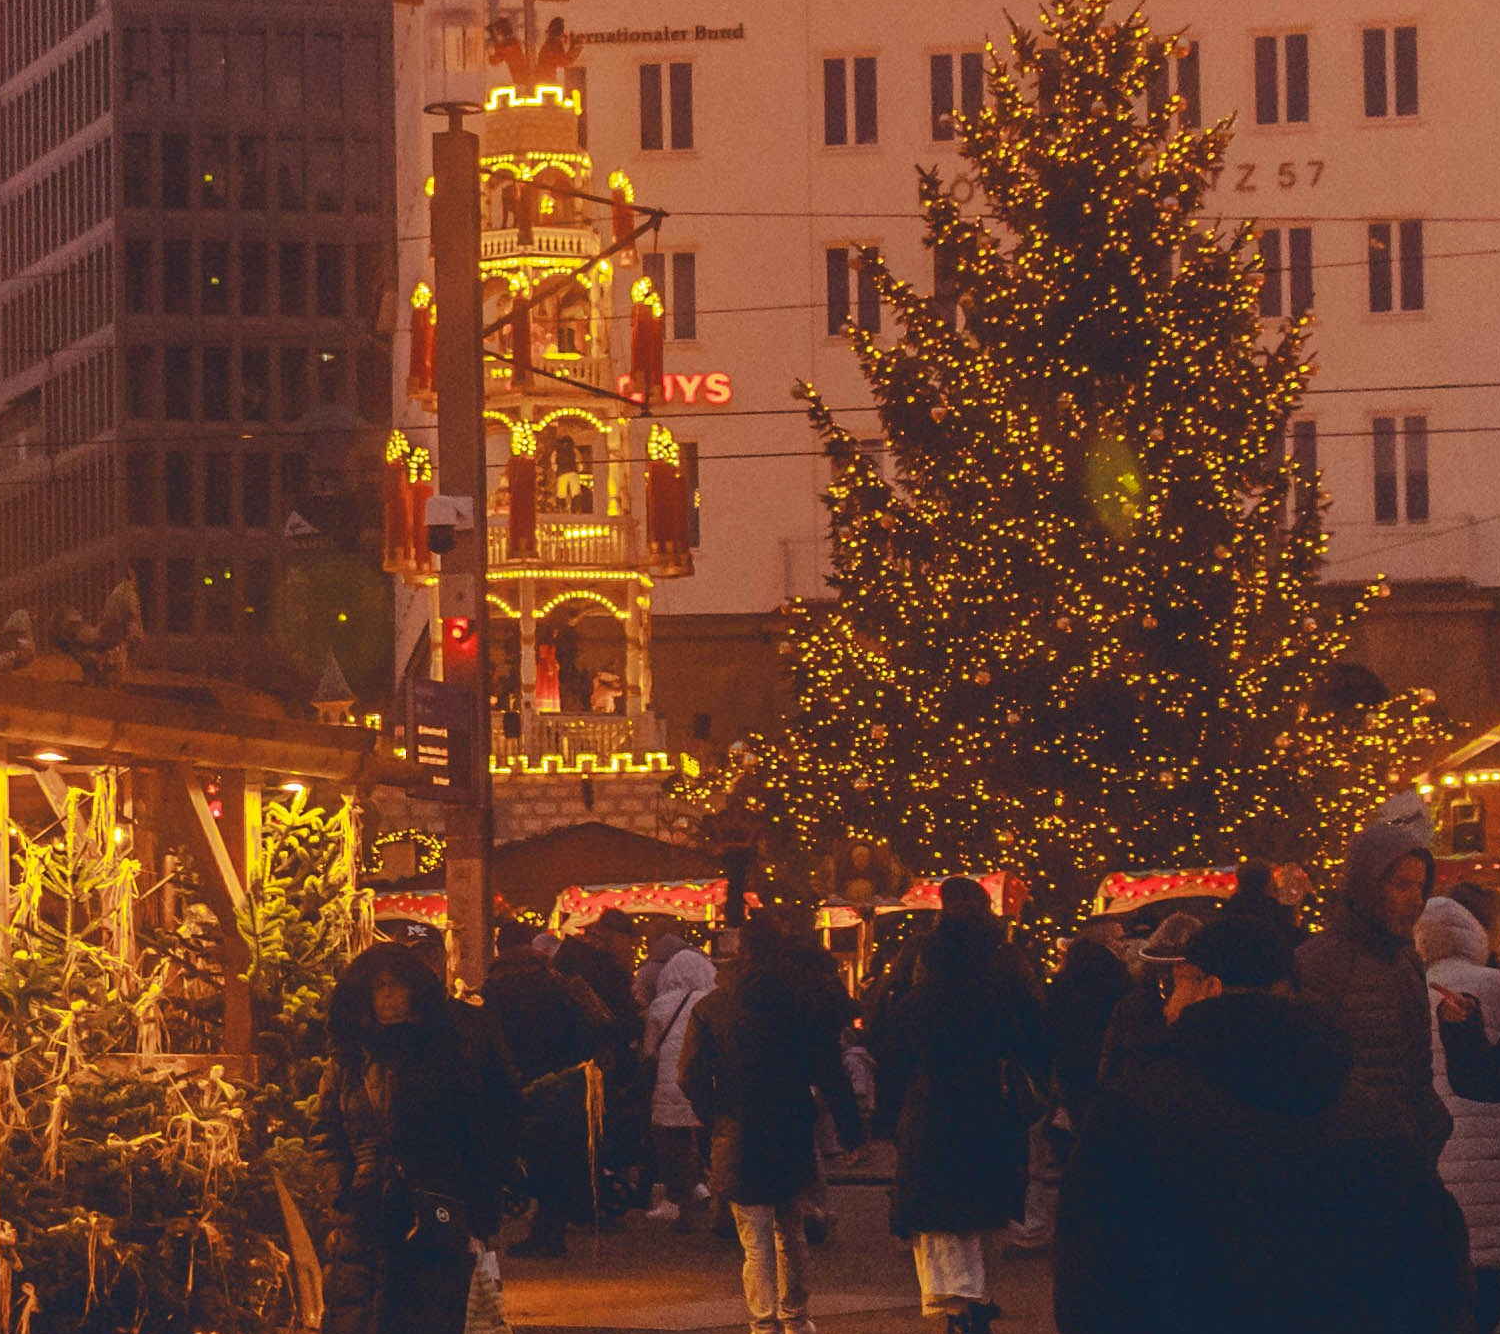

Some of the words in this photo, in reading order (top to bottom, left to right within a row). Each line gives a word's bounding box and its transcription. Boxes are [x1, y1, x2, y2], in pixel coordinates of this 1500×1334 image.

[559, 25, 687, 45] nternationaler
[695, 22, 745, 41] Bund
[1277, 159, 1325, 190] 57
